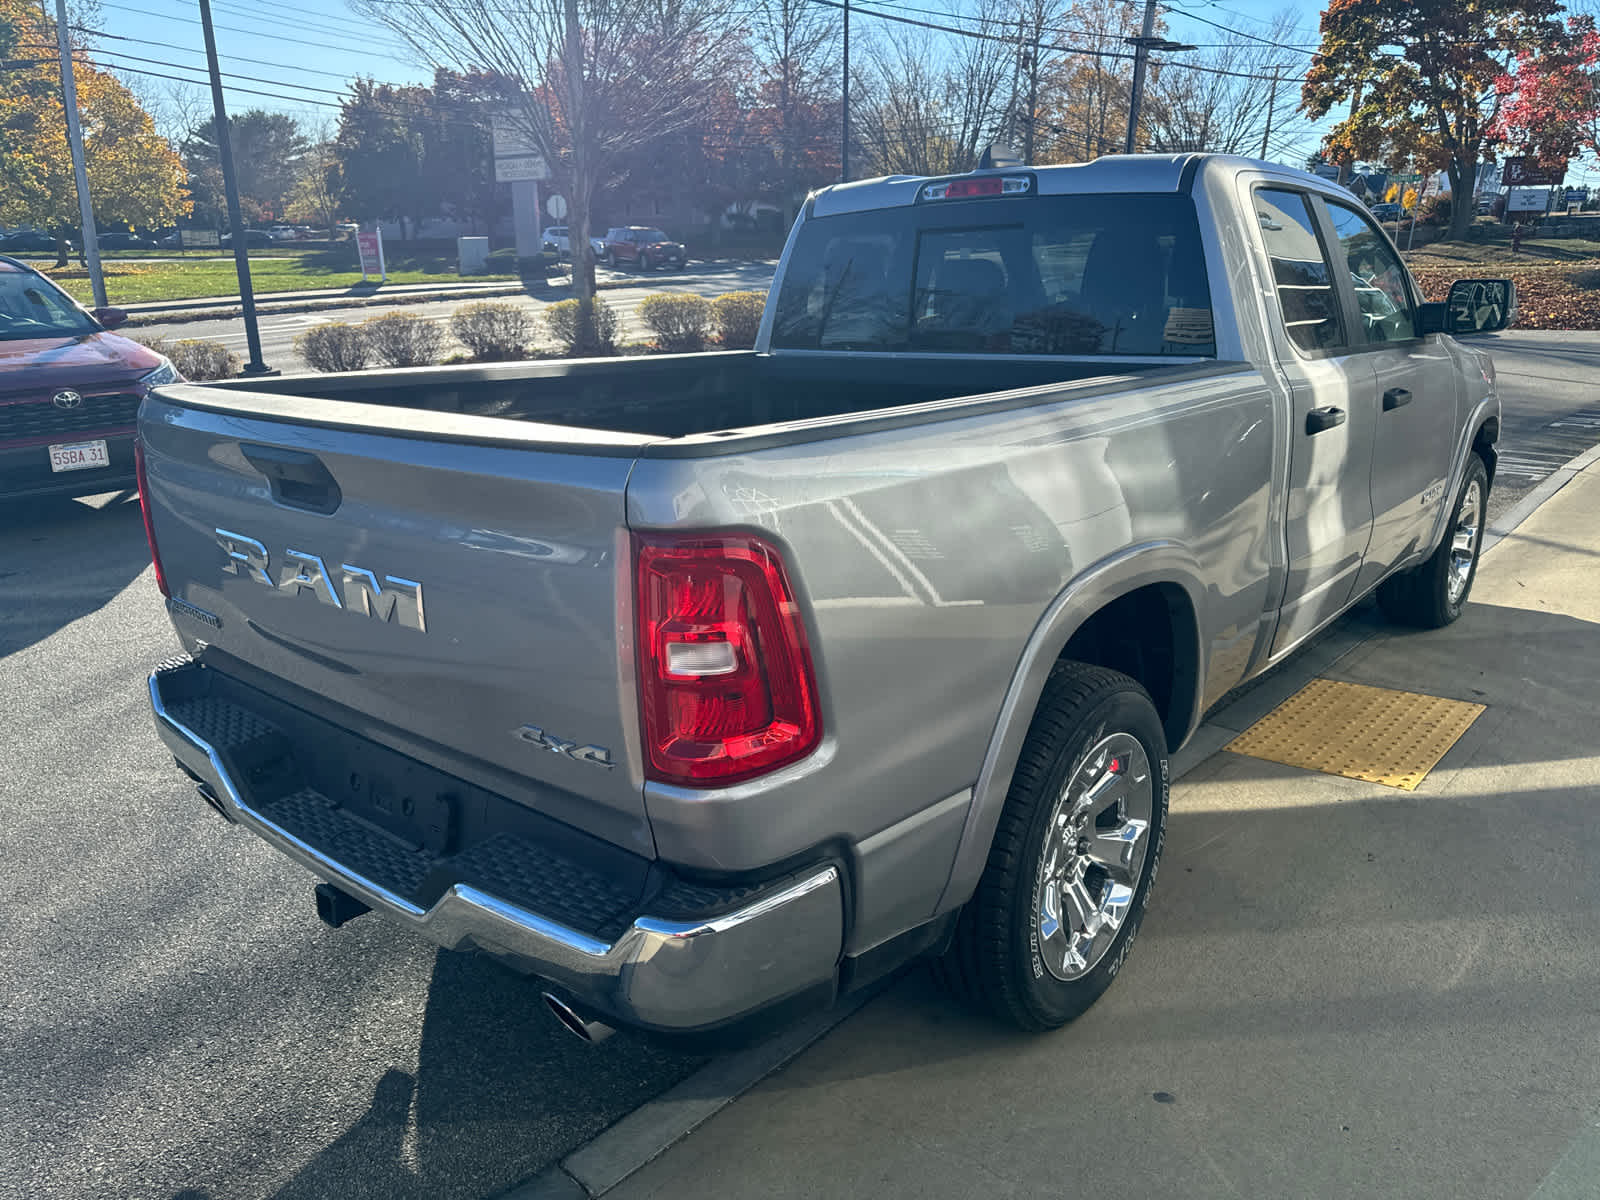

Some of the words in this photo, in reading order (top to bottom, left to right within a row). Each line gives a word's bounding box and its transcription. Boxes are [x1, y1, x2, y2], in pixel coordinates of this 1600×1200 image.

[53, 450, 85, 465] 5SBA
[89, 448, 104, 461] 31
[215, 527, 427, 633] RAM
